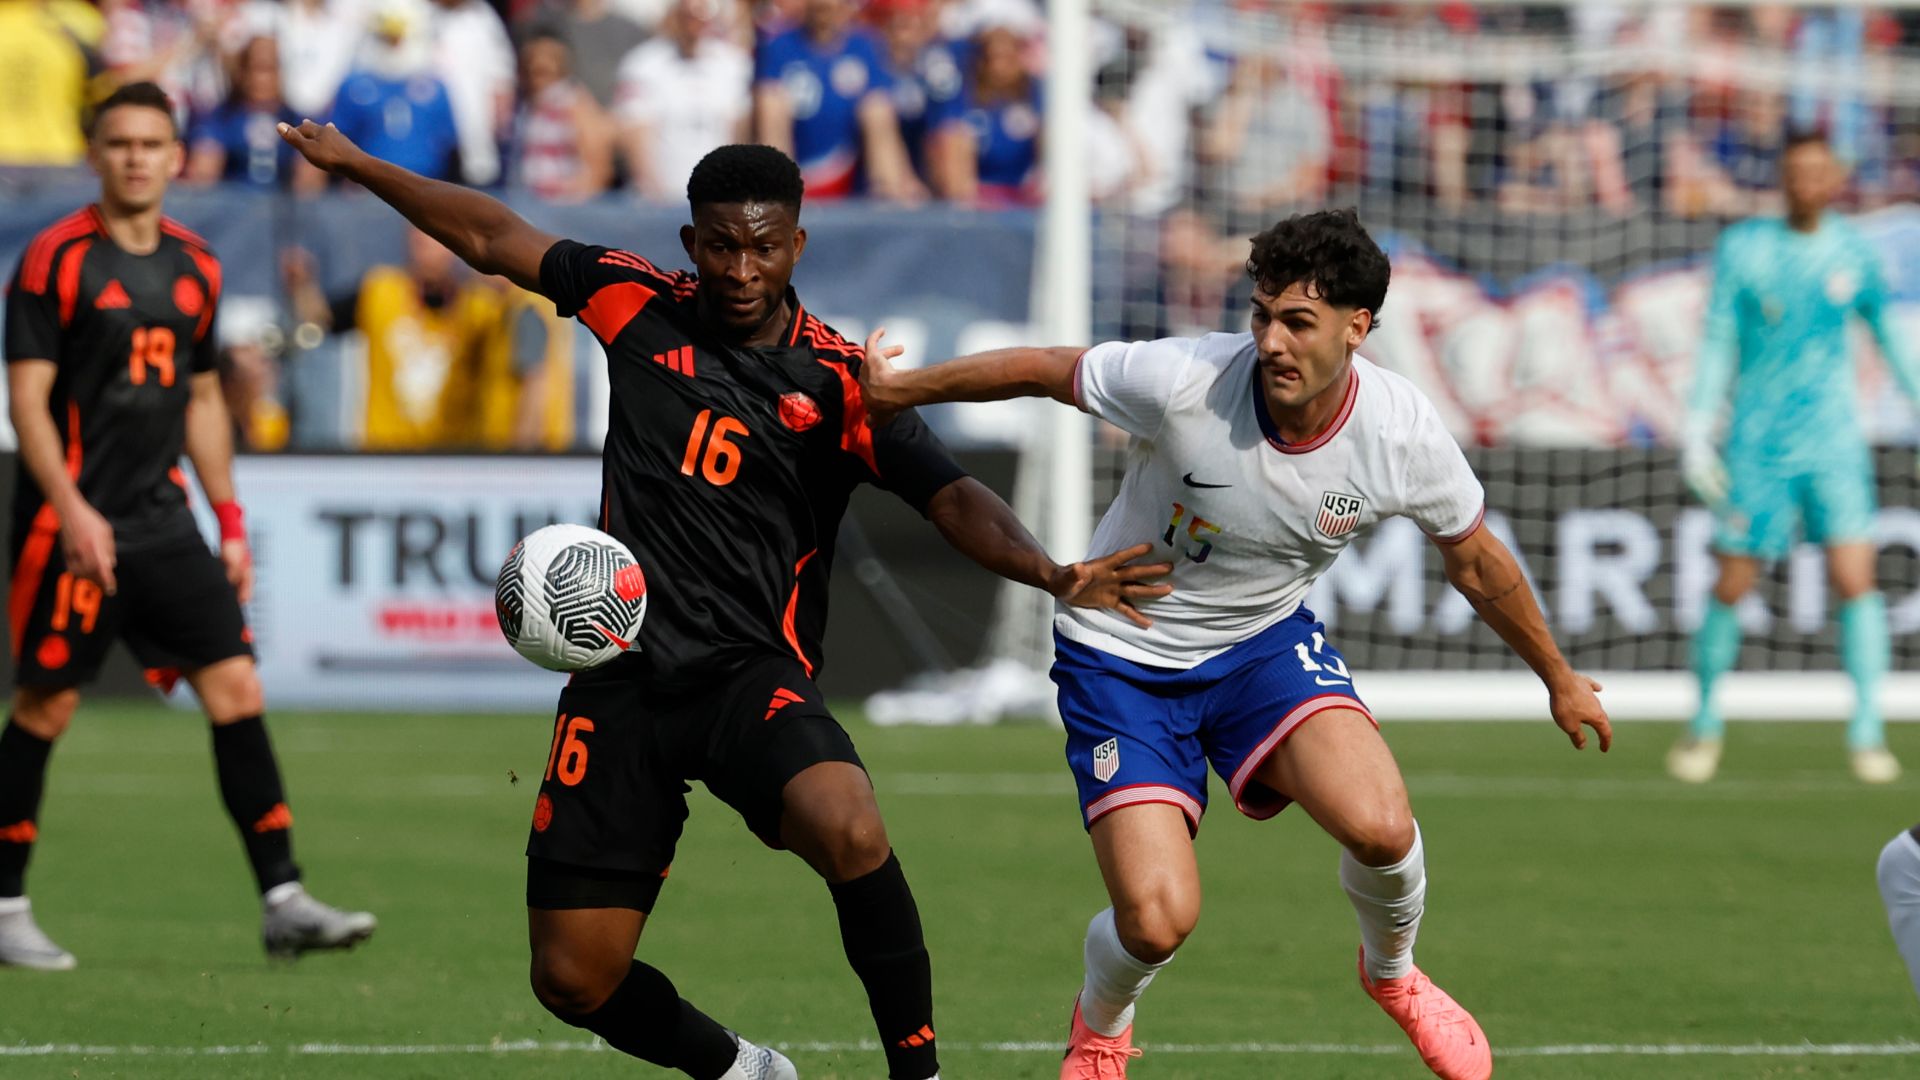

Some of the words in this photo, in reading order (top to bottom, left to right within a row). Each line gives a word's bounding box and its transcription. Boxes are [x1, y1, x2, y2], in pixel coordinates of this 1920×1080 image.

[128, 327, 176, 388] 19
[680, 408, 749, 487] 16
[1161, 502, 1222, 564] 15
[1324, 494, 1360, 516] USA
[315, 509, 603, 588] TRU
[51, 571, 103, 634] 19
[545, 712, 595, 787] 16
[1094, 740, 1116, 760] USA
